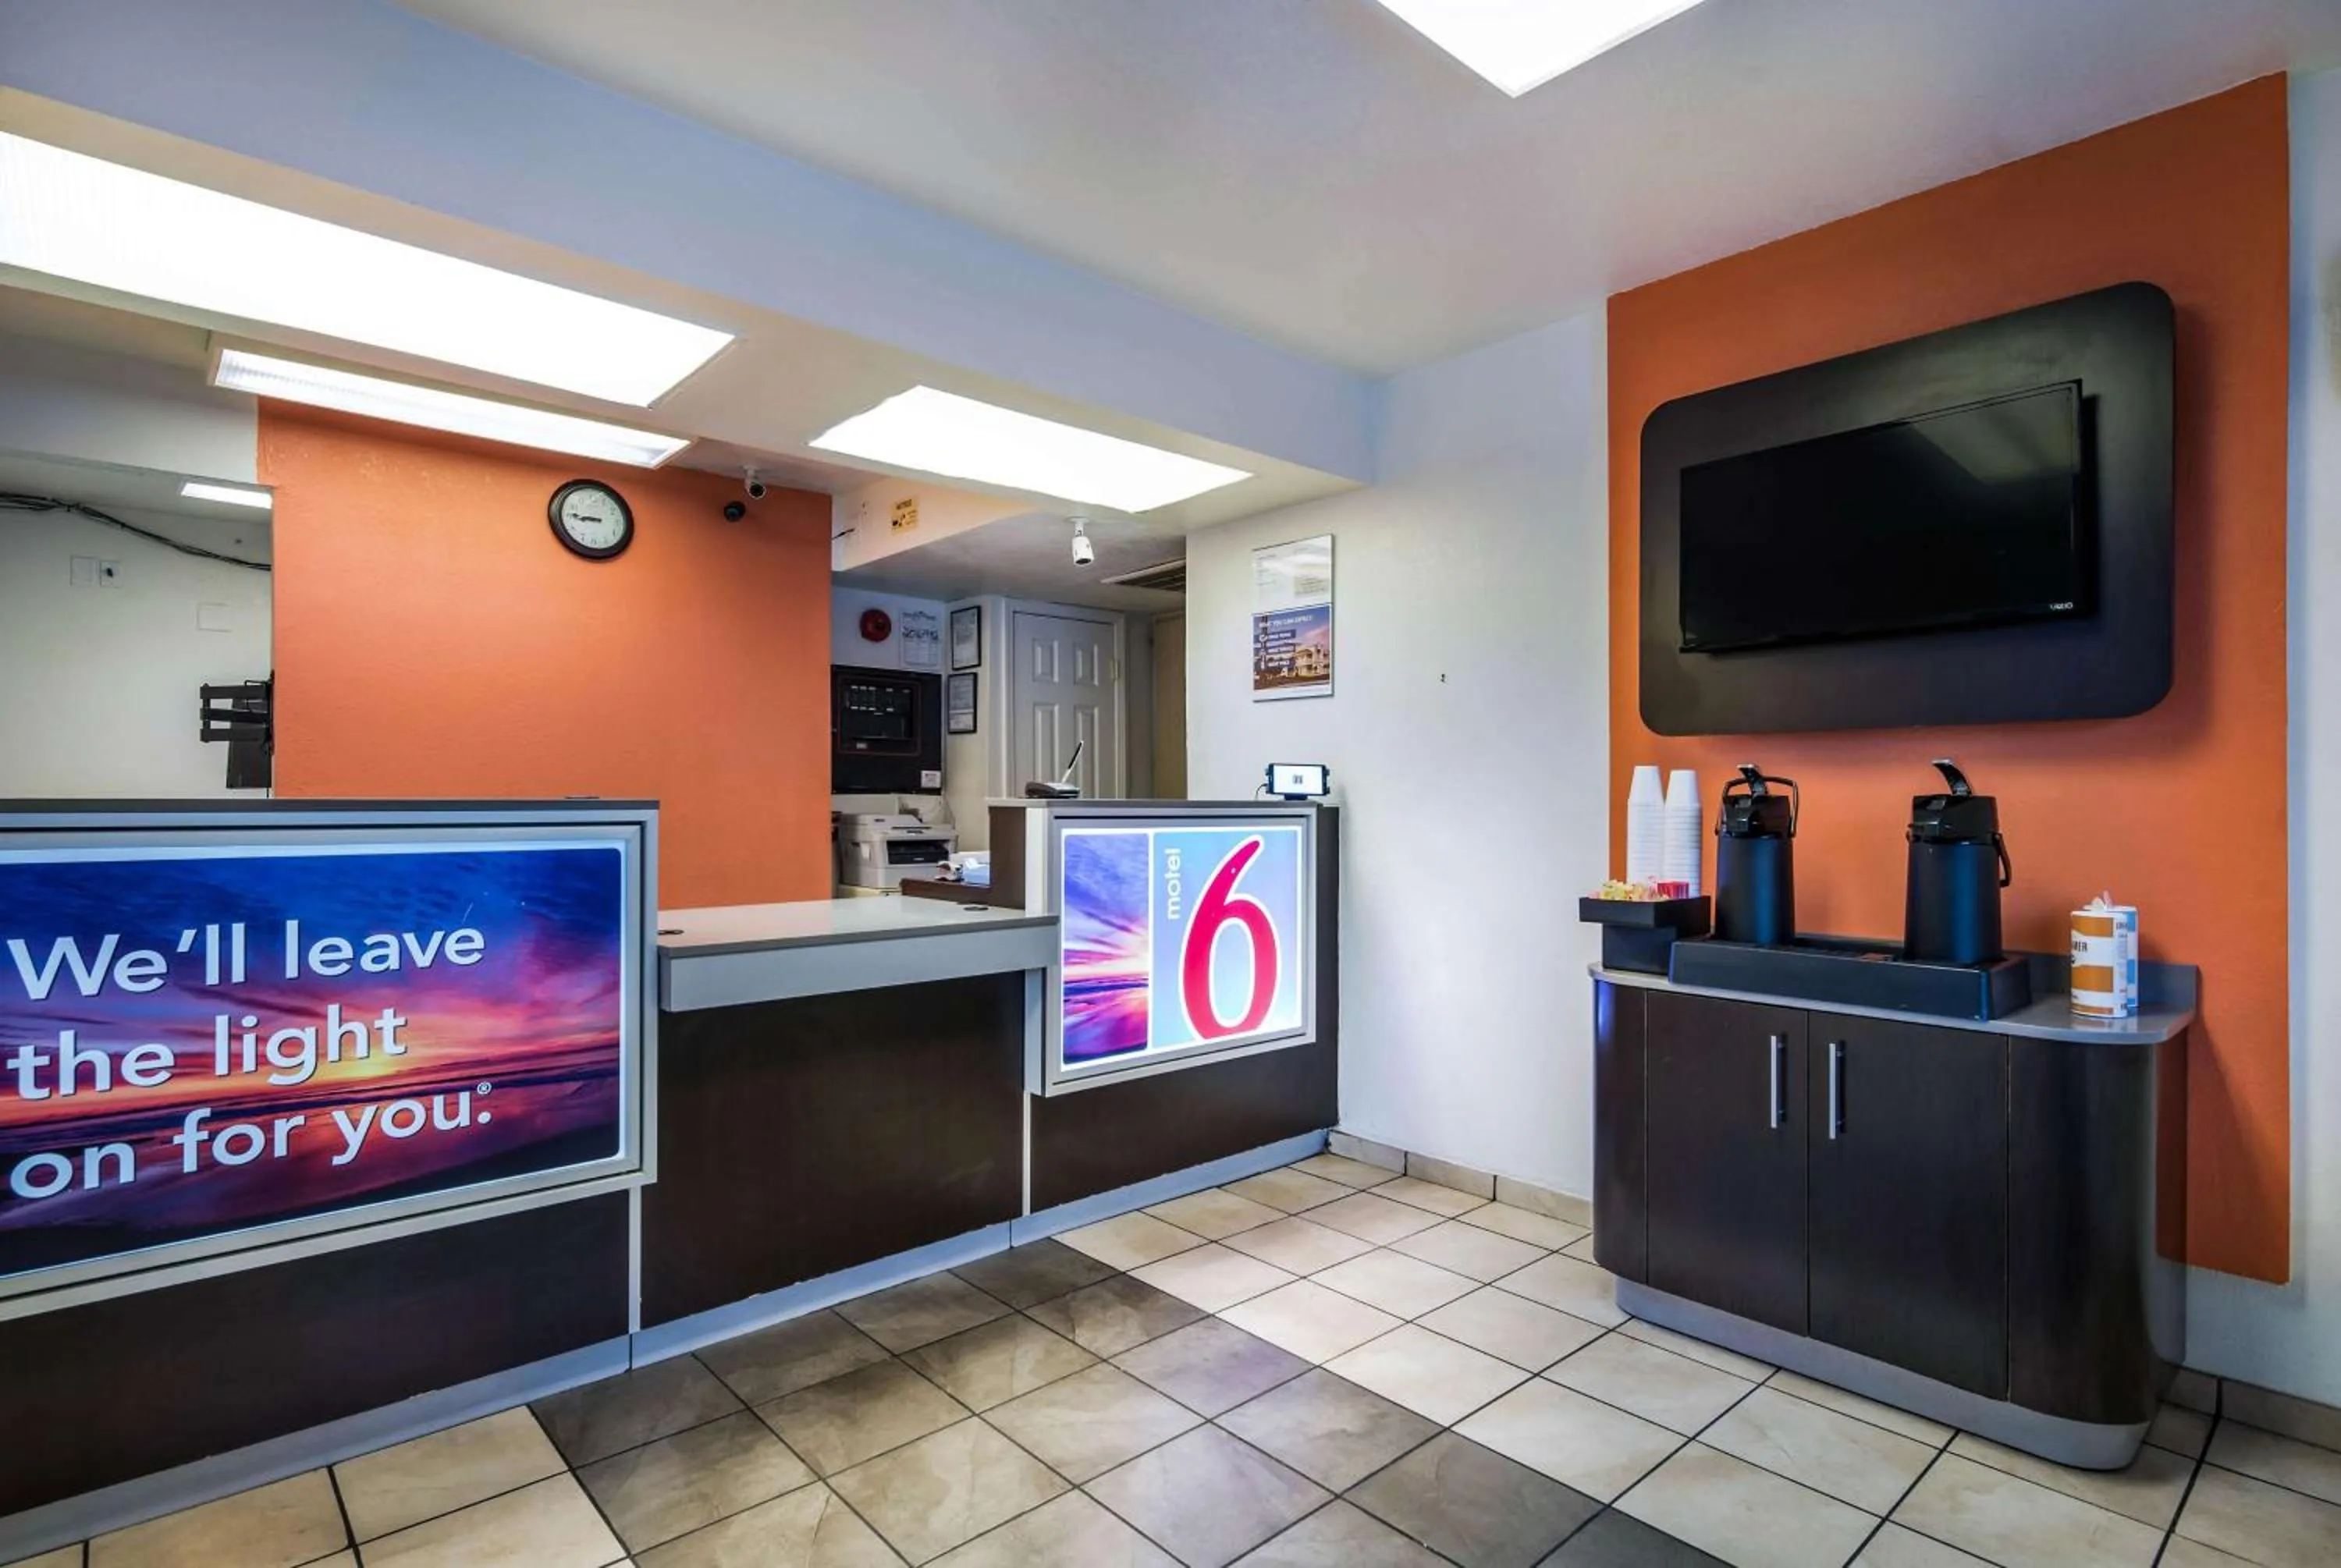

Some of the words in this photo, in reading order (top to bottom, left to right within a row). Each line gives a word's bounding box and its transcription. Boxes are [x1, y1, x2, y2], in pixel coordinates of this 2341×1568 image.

[1164, 847, 1181, 920] motel
[8, 923, 247, 1001] We'll
[285, 920, 485, 981] leave
[1180, 835, 1280, 1041] 6
[7, 1031, 175, 1101] the
[215, 1004, 408, 1085] light
[10, 1141, 136, 1200] on
[173, 1108, 306, 1174] for
